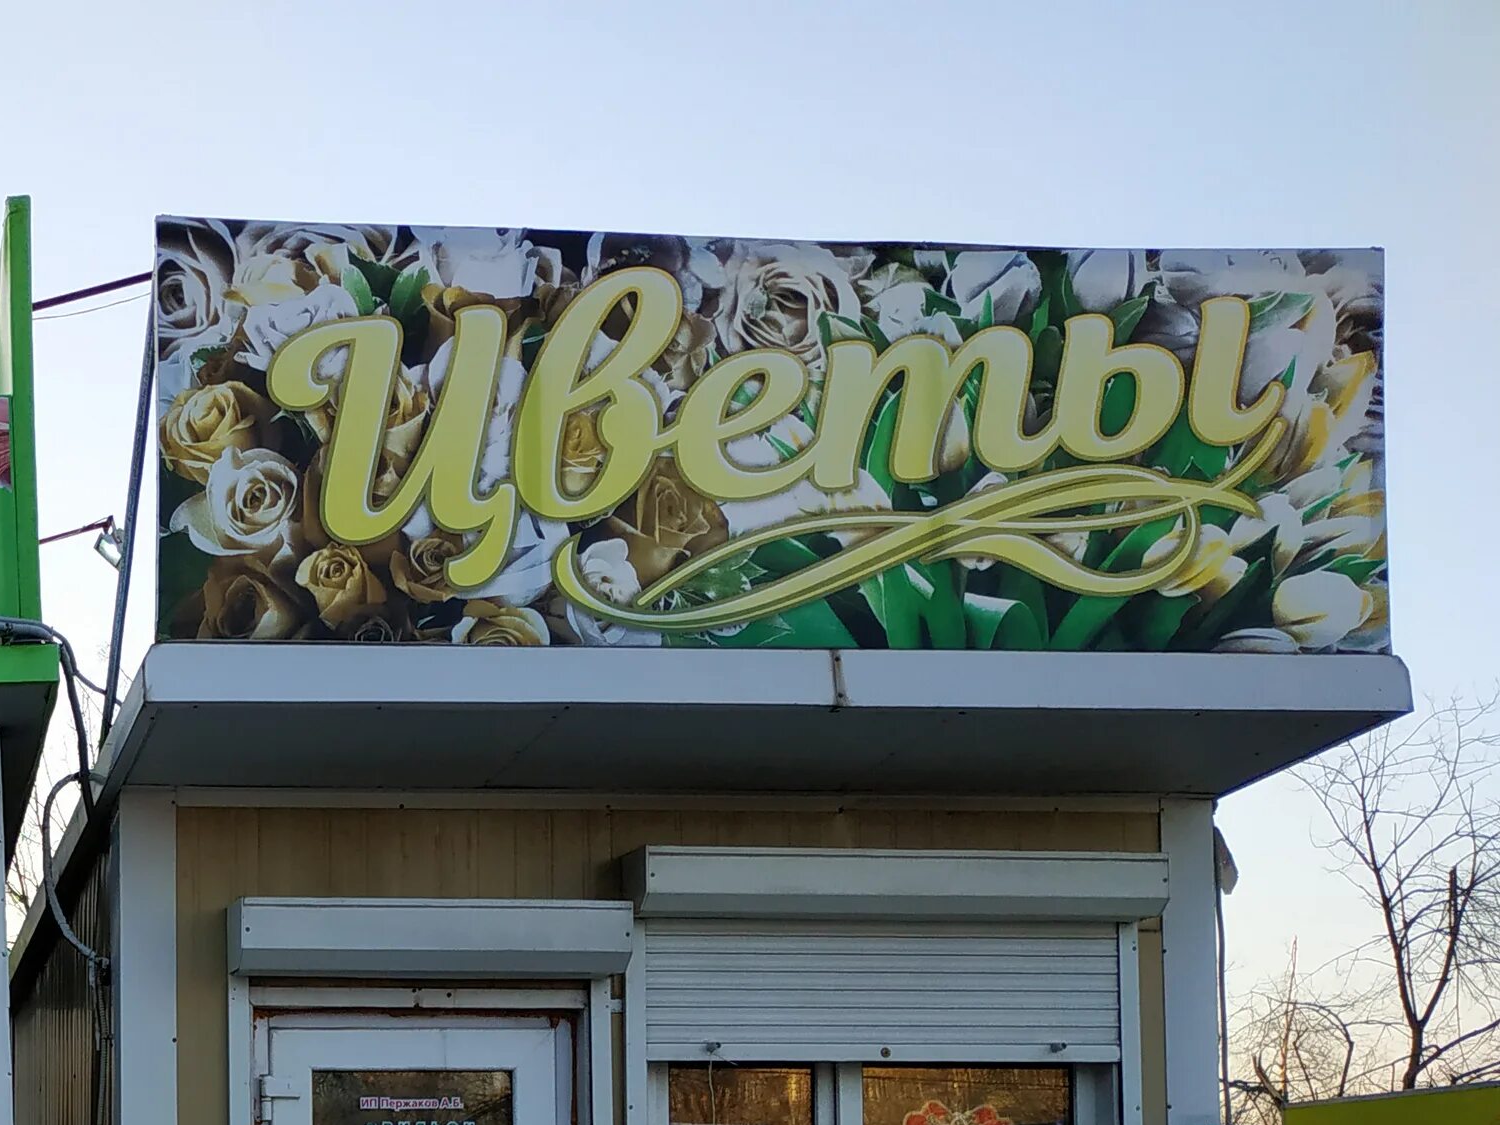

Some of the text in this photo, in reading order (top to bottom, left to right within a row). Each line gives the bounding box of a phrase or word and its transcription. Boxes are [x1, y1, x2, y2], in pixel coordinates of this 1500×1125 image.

[267, 267, 1288, 591] Цветы
[360, 1096, 464, 1111] ИП Пержаков А.Б.
